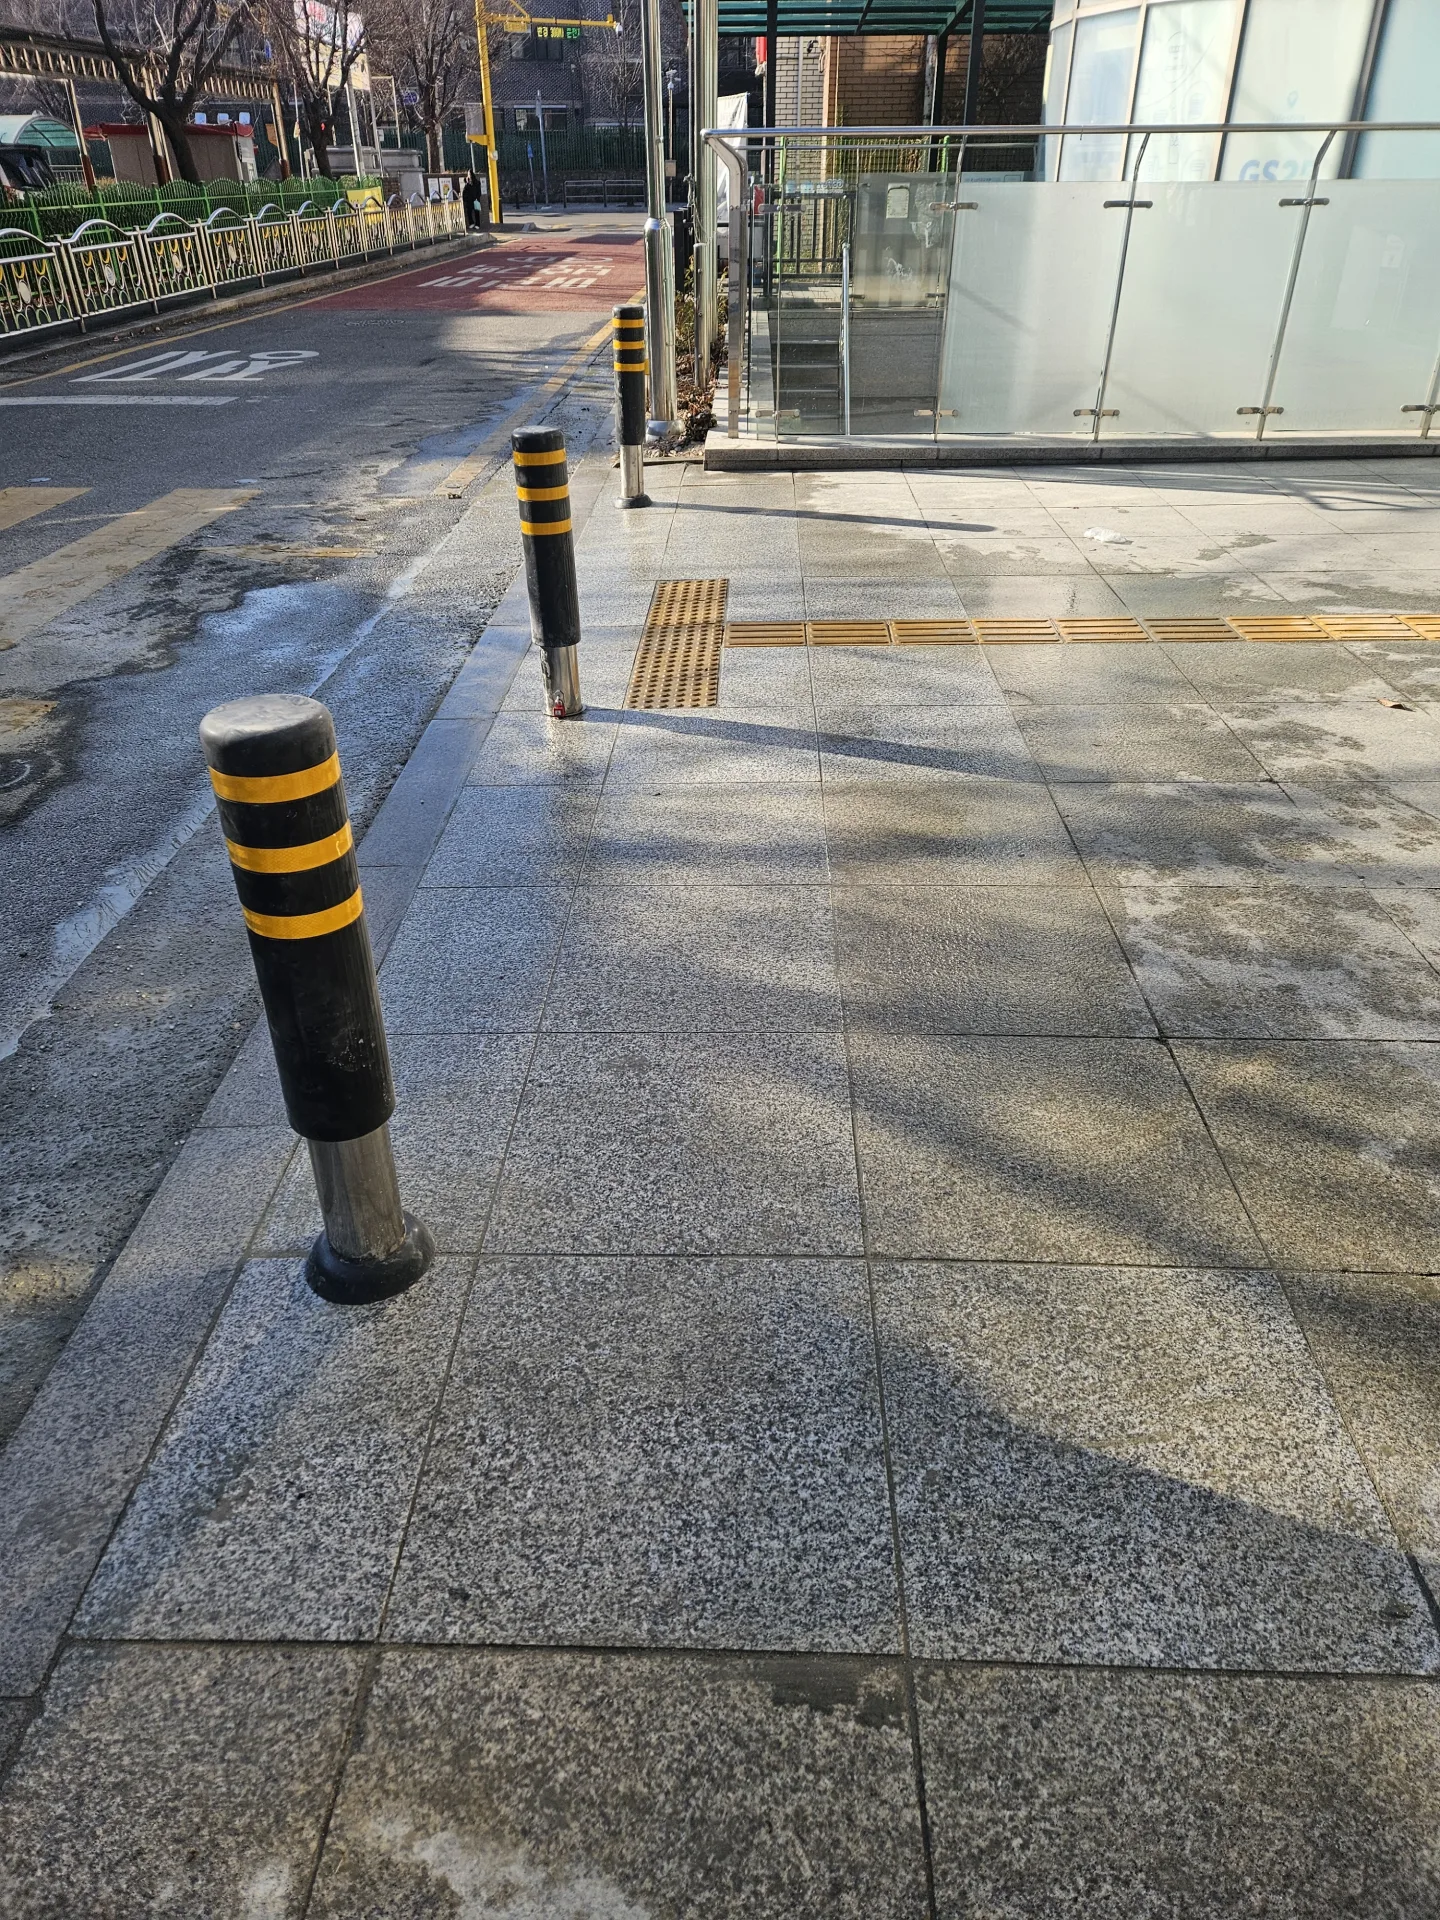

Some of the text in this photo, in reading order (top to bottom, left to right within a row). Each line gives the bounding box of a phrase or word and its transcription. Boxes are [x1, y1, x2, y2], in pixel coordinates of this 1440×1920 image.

[457, 264, 615, 276] 보호구역
[416, 275, 598, 289] 어린이
[67, 350, 320, 382] 정지
